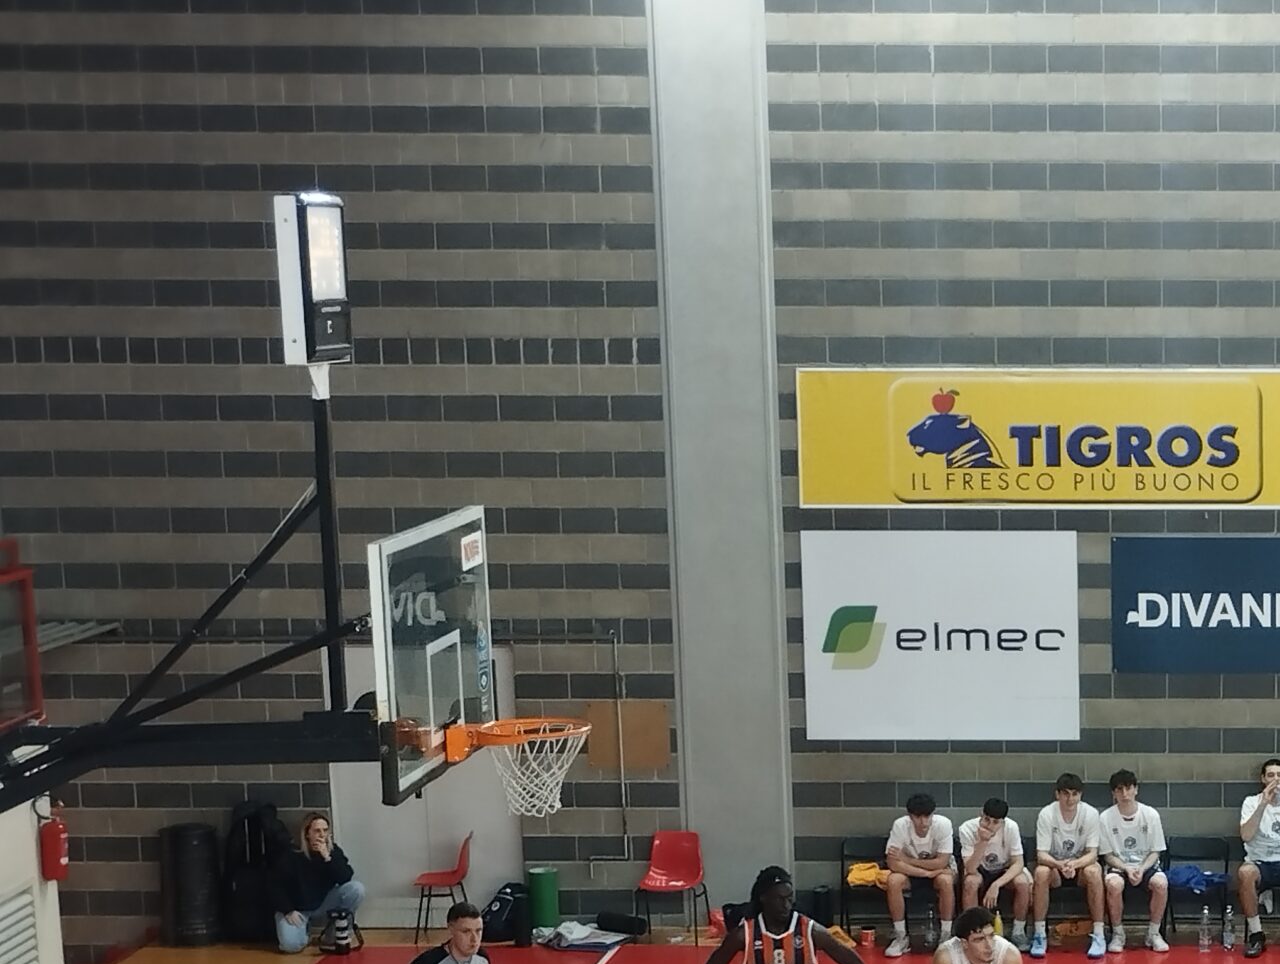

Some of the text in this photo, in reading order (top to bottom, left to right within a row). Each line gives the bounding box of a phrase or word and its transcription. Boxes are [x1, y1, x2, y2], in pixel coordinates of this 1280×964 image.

[1009, 424, 1241, 468] TIGROS
[911, 468, 1240, 491] IL FRESCO PIÙ BUONO
[895, 622, 1066, 652] elmec
